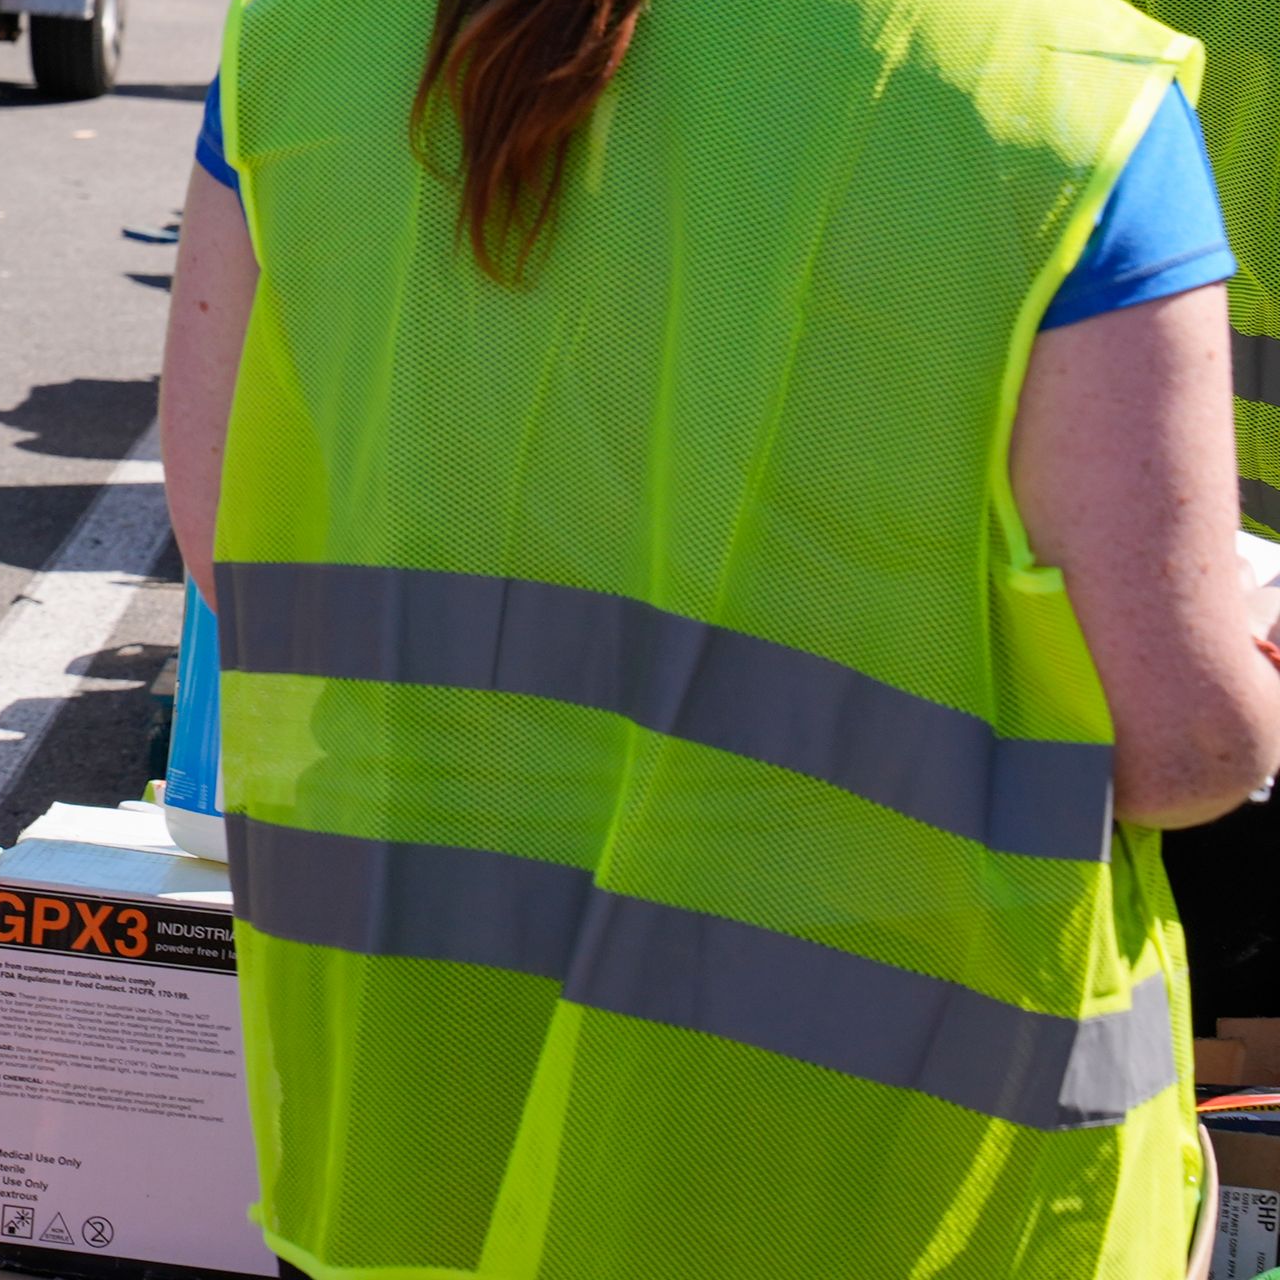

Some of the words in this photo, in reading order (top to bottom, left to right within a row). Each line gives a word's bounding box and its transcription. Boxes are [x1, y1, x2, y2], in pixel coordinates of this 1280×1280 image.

[155, 943, 195, 955] powder
[197, 946, 219, 958] free
[4, 961, 21, 971] from
[24, 963, 64, 977] component
[67, 968, 101, 980] materials
[104, 972, 126, 982] which
[128, 975, 155, 987] comply
[2, 1074, 42, 1085] CHEMICAL:
[36, 1153, 55, 1164] Use
[58, 1156, 82, 1169] Only
[2, 1176, 22, 1187] Use
[25, 1178, 49, 1192] Only
[1257, 1195, 1277, 1232] SHP
